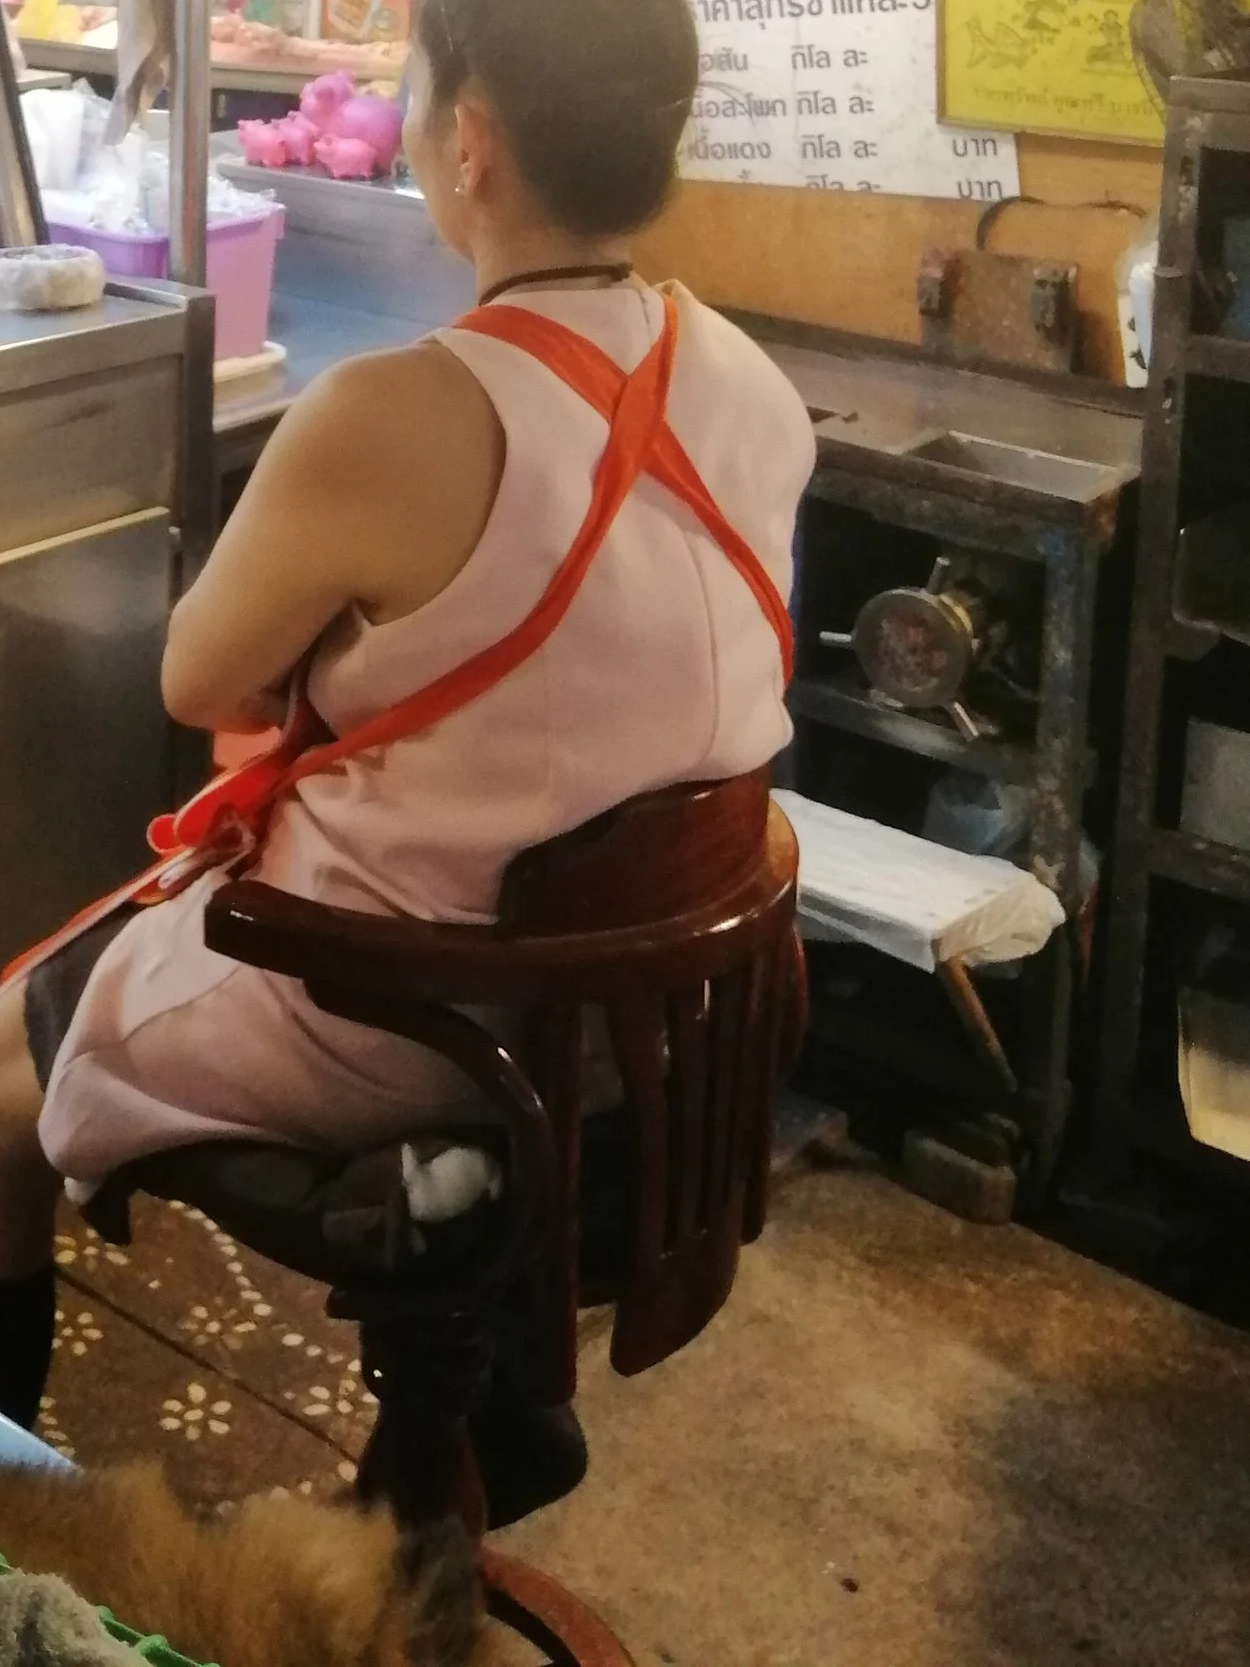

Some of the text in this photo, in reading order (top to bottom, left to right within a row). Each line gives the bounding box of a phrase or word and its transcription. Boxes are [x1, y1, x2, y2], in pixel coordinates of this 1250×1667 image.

[791, 44, 831, 70] กิโล
[843, 48, 869, 70] ละ
[798, 90, 837, 116] กิโล
[849, 96, 874, 115] ละ
[802, 134, 841, 160] กิโล
[853, 140, 878, 160] ละ
[952, 136, 998, 158] บาท
[957, 179, 1003, 201] บาท
